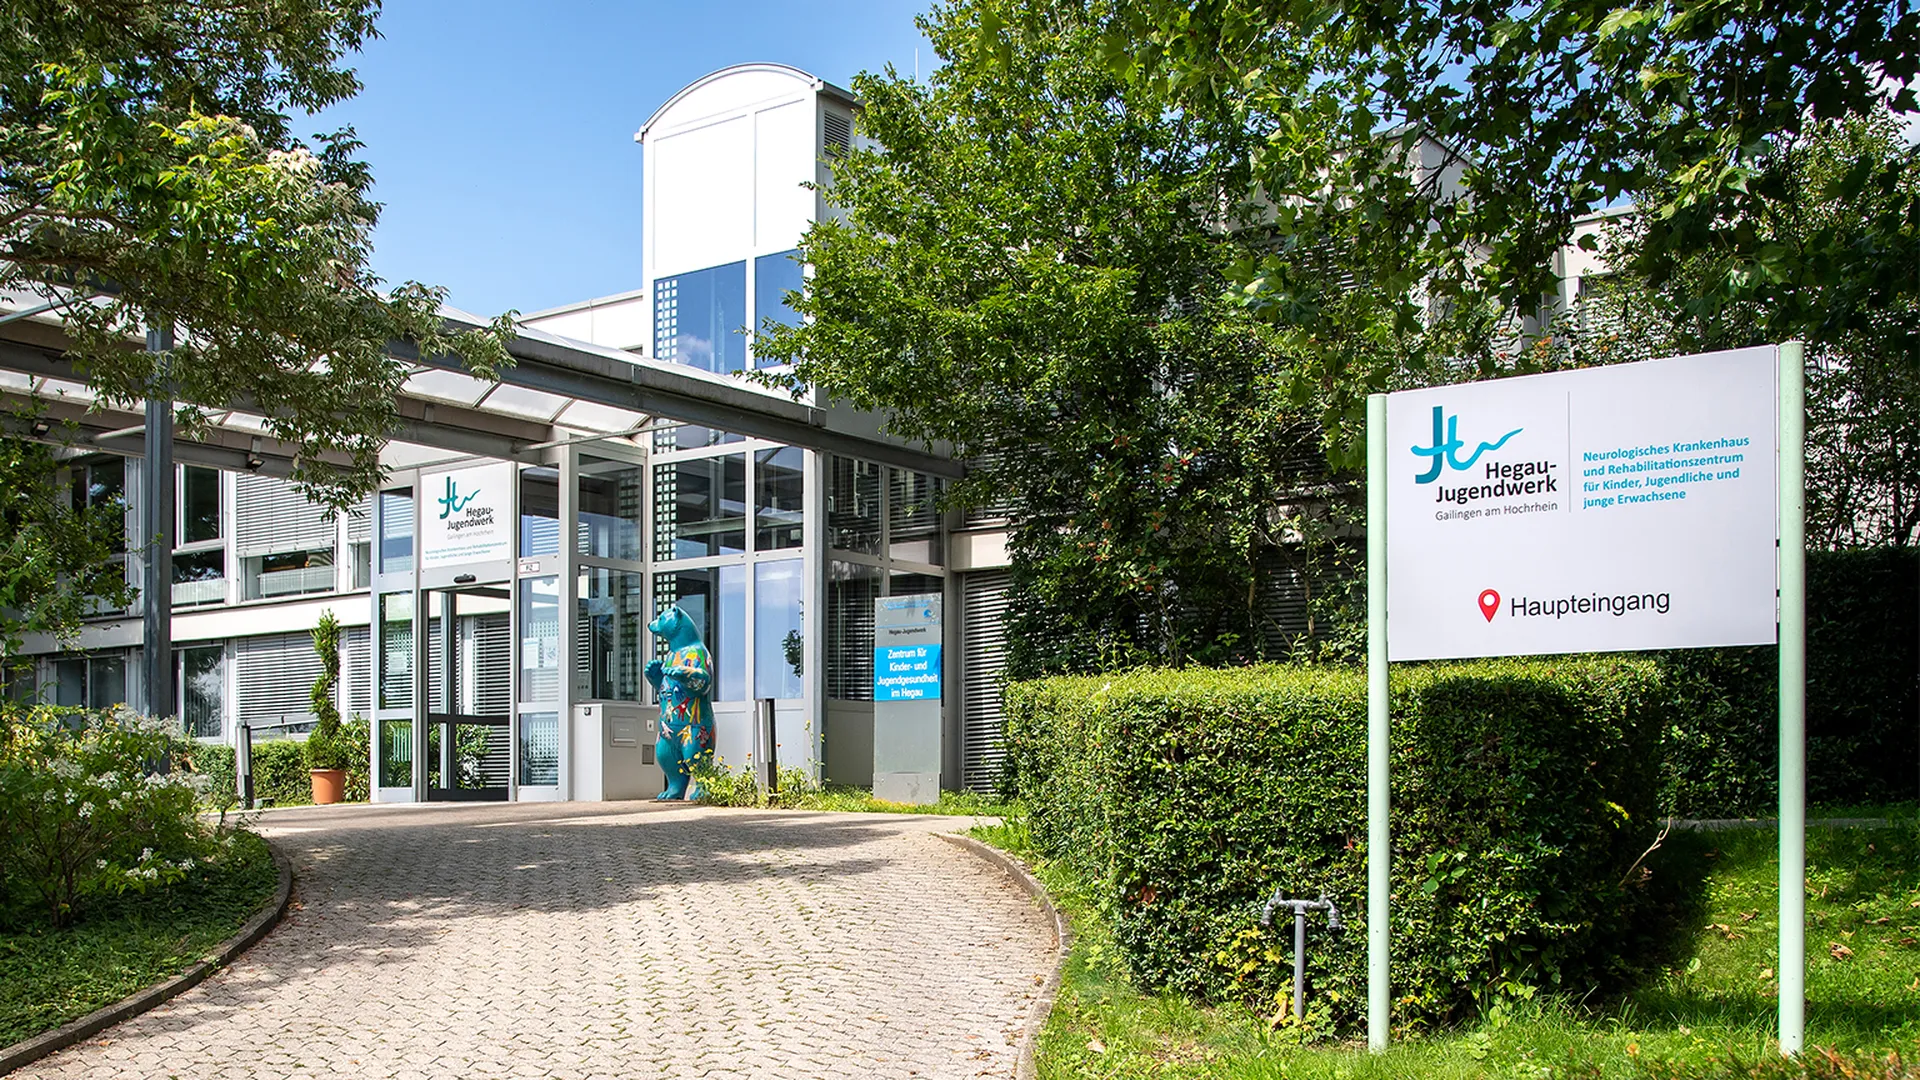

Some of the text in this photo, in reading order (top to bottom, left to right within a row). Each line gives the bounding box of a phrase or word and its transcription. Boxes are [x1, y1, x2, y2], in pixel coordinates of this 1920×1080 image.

[1583, 436, 1750, 462] Neurologisches Krankenhaus
[1486, 461, 1557, 480] Hegau-
[1583, 454, 1744, 477] und Rehabilitationszentrum
[1436, 475, 1557, 504] Jugendwerk
[1583, 468, 1740, 492] für Kinder, Jugendliche und
[1583, 490, 1686, 510] junge Erwachsene
[466, 507, 494, 518] Hegau-
[1435, 501, 1558, 521] Gailingen am Hochrhein
[447, 515, 494, 531] Jugendwerk
[1511, 593, 1670, 619] Haupteingang
[888, 648, 927, 659] Zentrum für
[889, 661, 927, 672] Kinder- und
[877, 673, 938, 687] Jugendgesundheit
[891, 688, 923, 699] im Hegau
